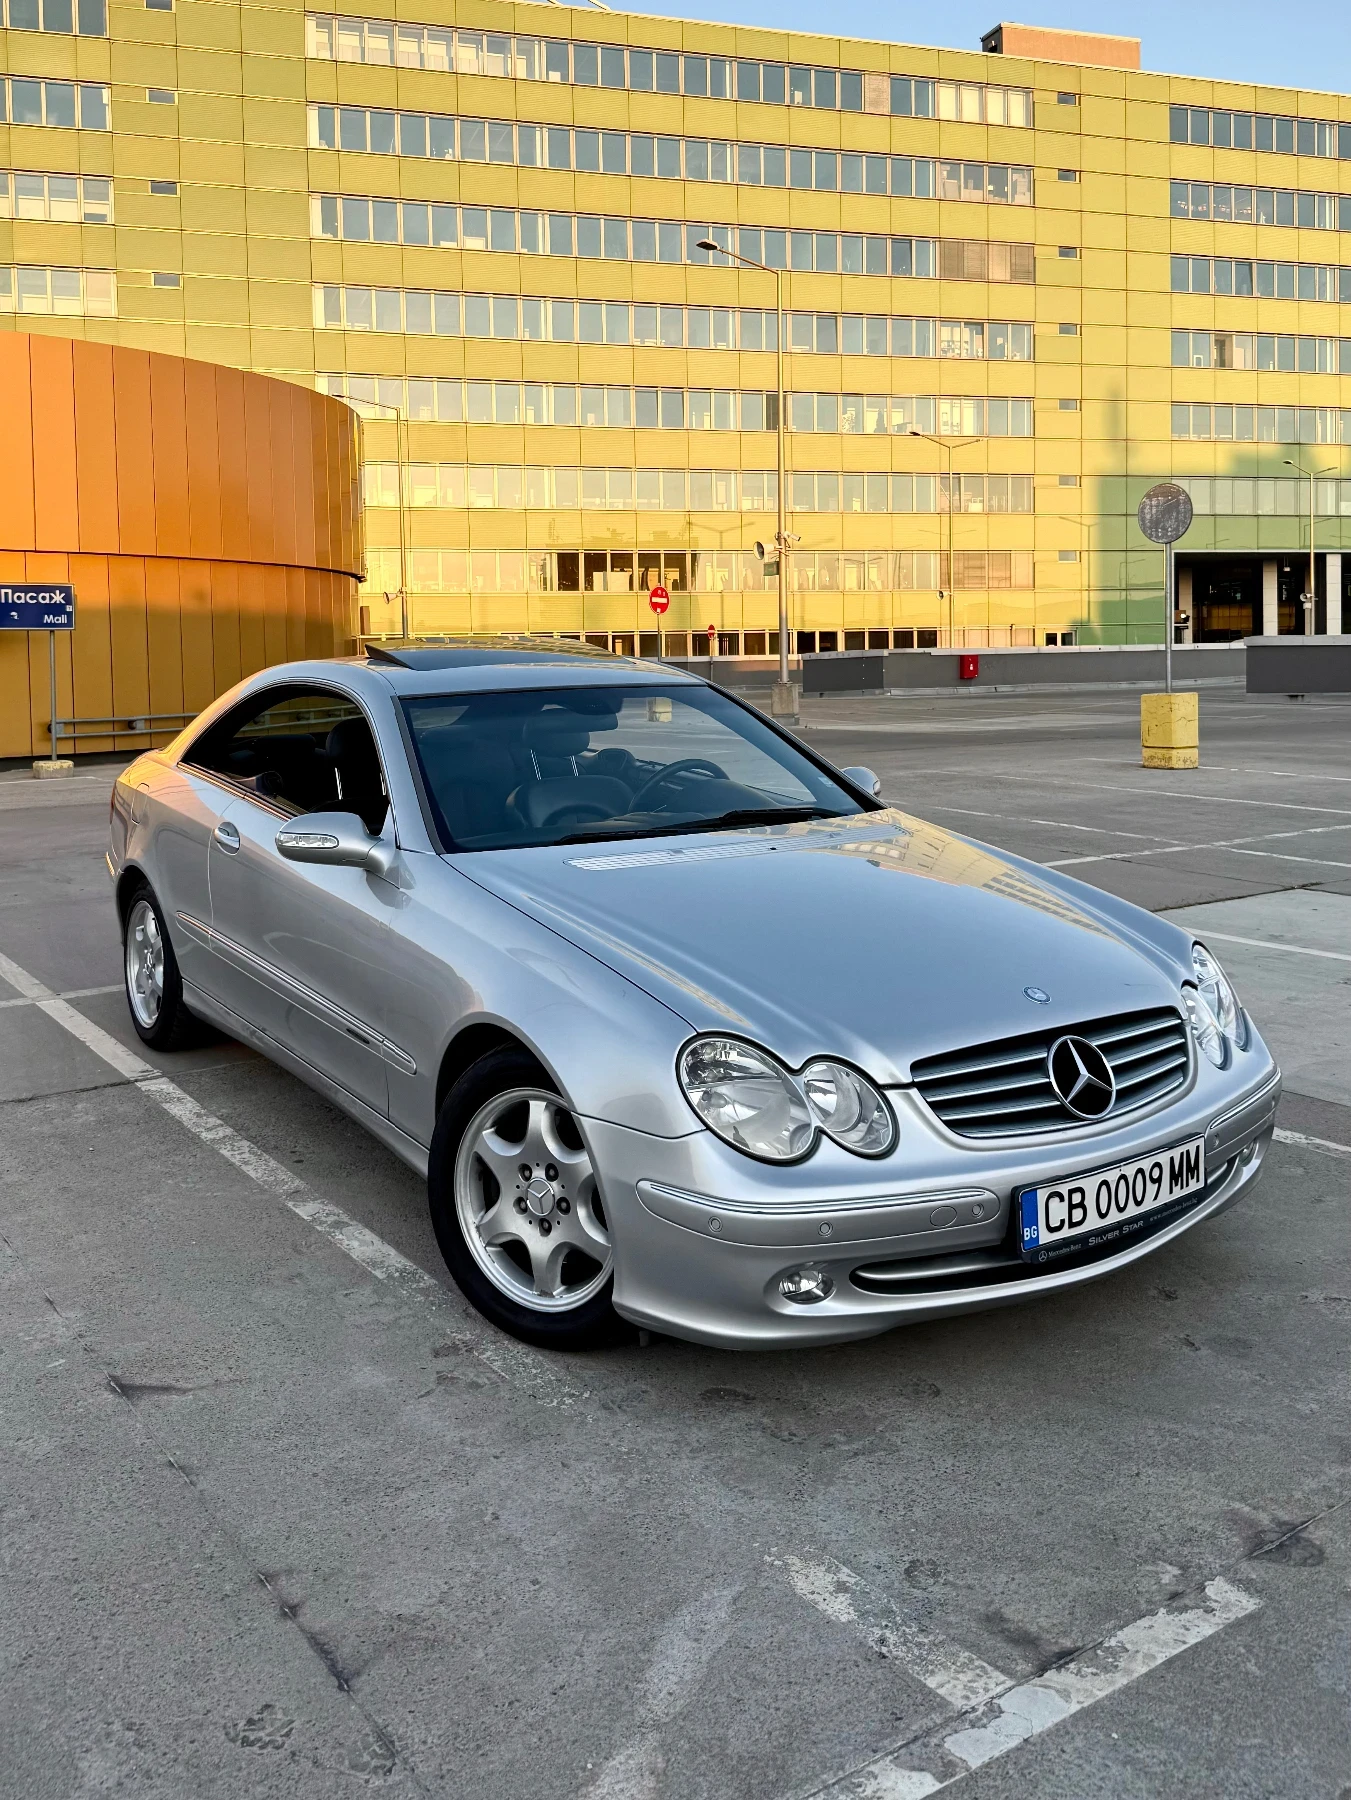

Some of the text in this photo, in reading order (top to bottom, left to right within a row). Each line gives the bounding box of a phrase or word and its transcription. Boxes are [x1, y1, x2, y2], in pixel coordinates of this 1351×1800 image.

[0, 588, 66, 604] Пасаж
[43, 614, 68, 624] Mall
[1044, 1144, 1200, 1234] CB 0009 MM
[1023, 1225, 1038, 1241] BG
